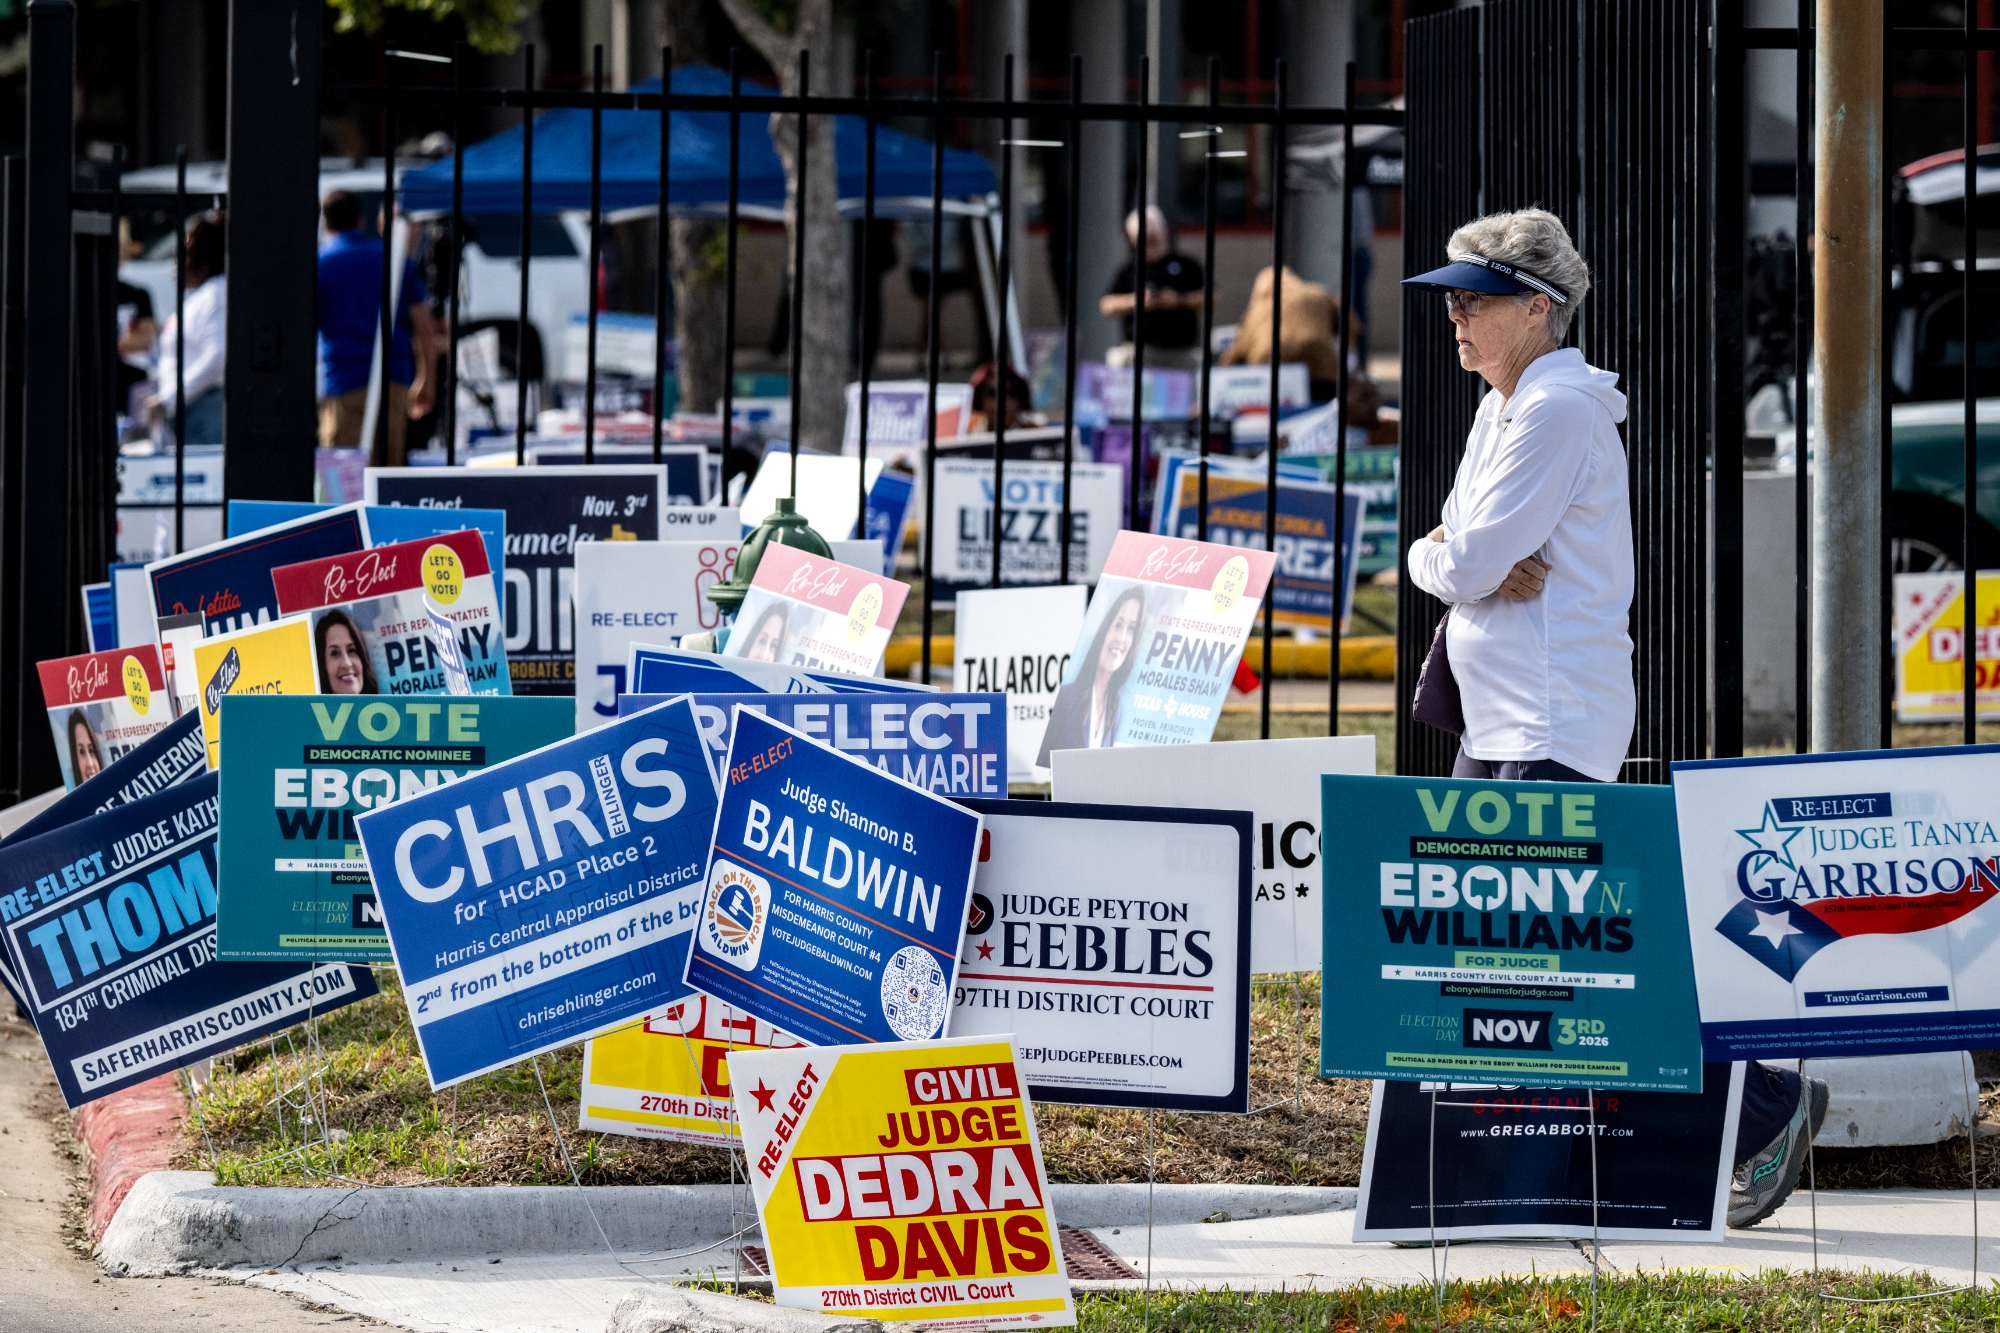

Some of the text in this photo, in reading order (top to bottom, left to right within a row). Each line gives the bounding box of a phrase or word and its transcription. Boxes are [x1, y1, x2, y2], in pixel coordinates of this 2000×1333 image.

[1490, 261, 1512, 276] IZOD
[583, 494, 648, 516] Nov. 3rd
[666, 513, 718, 525] OW UP
[505, 524, 599, 556] amel
[959, 507, 1088, 544] LIZZIE
[325, 552, 398, 605] Re-Elect
[429, 555, 454, 567] LET'S
[436, 571, 451, 581] GO
[1139, 544, 1208, 580] Re-Elect
[431, 584, 458, 596] VOTE!
[784, 562, 848, 600] Re-Elect
[380, 607, 490, 638] STATE REPNTATIVE
[592, 613, 680, 627] RE-ELECT
[508, 661, 562, 681] ROBATE
[1146, 631, 1237, 677] PENNY
[67, 657, 109, 703] Re-Elect
[391, 662, 498, 695] MORALE HAW
[1136, 671, 1223, 696] MORALES SHAW
[311, 702, 481, 741] VOTE
[702, 702, 992, 752] RELECT
[309, 749, 472, 761] DEMOCRATIC NOMINEE
[730, 736, 794, 785] RE-ELECT
[903, 753, 999, 794] MARIE
[594, 755, 626, 836] EHLINGER
[1415, 788, 1597, 838] VOTE
[1791, 798, 1877, 818] RE-ELECT
[394, 737, 688, 904] CHRIS
[780, 776, 918, 856] Judge Shannon B.
[1416, 841, 1588, 859] DEMOCRATIC NOMINEE
[1808, 820, 2000, 858] JUDGE TANYA
[0, 850, 107, 923] RE-ELECT
[112, 820, 175, 870] JUDGE
[454, 836, 659, 925] for HCAD Place 2
[742, 798, 943, 933] BALDWIN
[1736, 849, 2000, 903] GARRISON
[292, 901, 350, 913] ELECTION
[1380, 862, 1633, 915] EBONY N.
[27, 850, 219, 990] THOM
[326, 914, 350, 925] DAY
[435, 938, 486, 969] Harris
[489, 914, 552, 953] Central
[554, 885, 636, 930] Appraisal
[638, 861, 699, 897] District
[708, 872, 762, 944] BACK ON THE BENCH
[783, 889, 874, 939] FOR HARRIS COUNTY
[1001, 895, 1188, 923] JUDGE PEYTON
[708, 922, 750, 957] BALDWIN
[771, 903, 882, 964] MISDEMEANOR COURT #4
[1381, 908, 1635, 953] WILLIAMS
[416, 984, 443, 1015] 2nd
[450, 970, 498, 1003] from
[501, 956, 535, 983] the
[539, 930, 613, 970] bottom
[616, 918, 639, 943] of
[640, 906, 675, 934] the
[770, 926, 873, 981] VOTEJUDGEBALDWIN.COM
[1000, 921, 1215, 979] EEBLES
[1465, 956, 1549, 968] FOR JUDGE
[1415, 970, 1447, 978] HARRIS
[1450, 972, 1485, 980] COUNTY
[1515, 974, 1544, 982] COURT
[1548, 975, 1559, 983] AT
[1445, 985, 1569, 998] ebonywilliamsforjudge.com
[55, 959, 192, 1032] 184TH CRIMINAL
[518, 971, 657, 1030] chrisehlinger.com
[955, 987, 1215, 1020] 97TH DISTRICT COURT
[1824, 989, 1928, 1005] TanyaGarrison.com
[81, 968, 347, 1083] SAFERHARRISCOUNTY.COM
[1399, 1014, 1459, 1028] ELECTION
[1435, 1028, 1460, 1041] DAY
[1473, 1016, 1606, 1046] NOV 3RD
[1019, 1047, 1183, 1070] EEPJUDGEPEEBLES.COM
[1579, 1035, 1609, 1046] 2026
[913, 1066, 1012, 1102] CIVIL
[641, 1096, 739, 1122] 270th Distr
[757, 1063, 820, 1179] RE-ELECT
[878, 1105, 1021, 1149] JUDGE
[797, 1146, 1042, 1220] DEDRA
[854, 1213, 1056, 1281] DAVIS
[821, 1281, 1015, 1307] 270th District CIVIL Court
